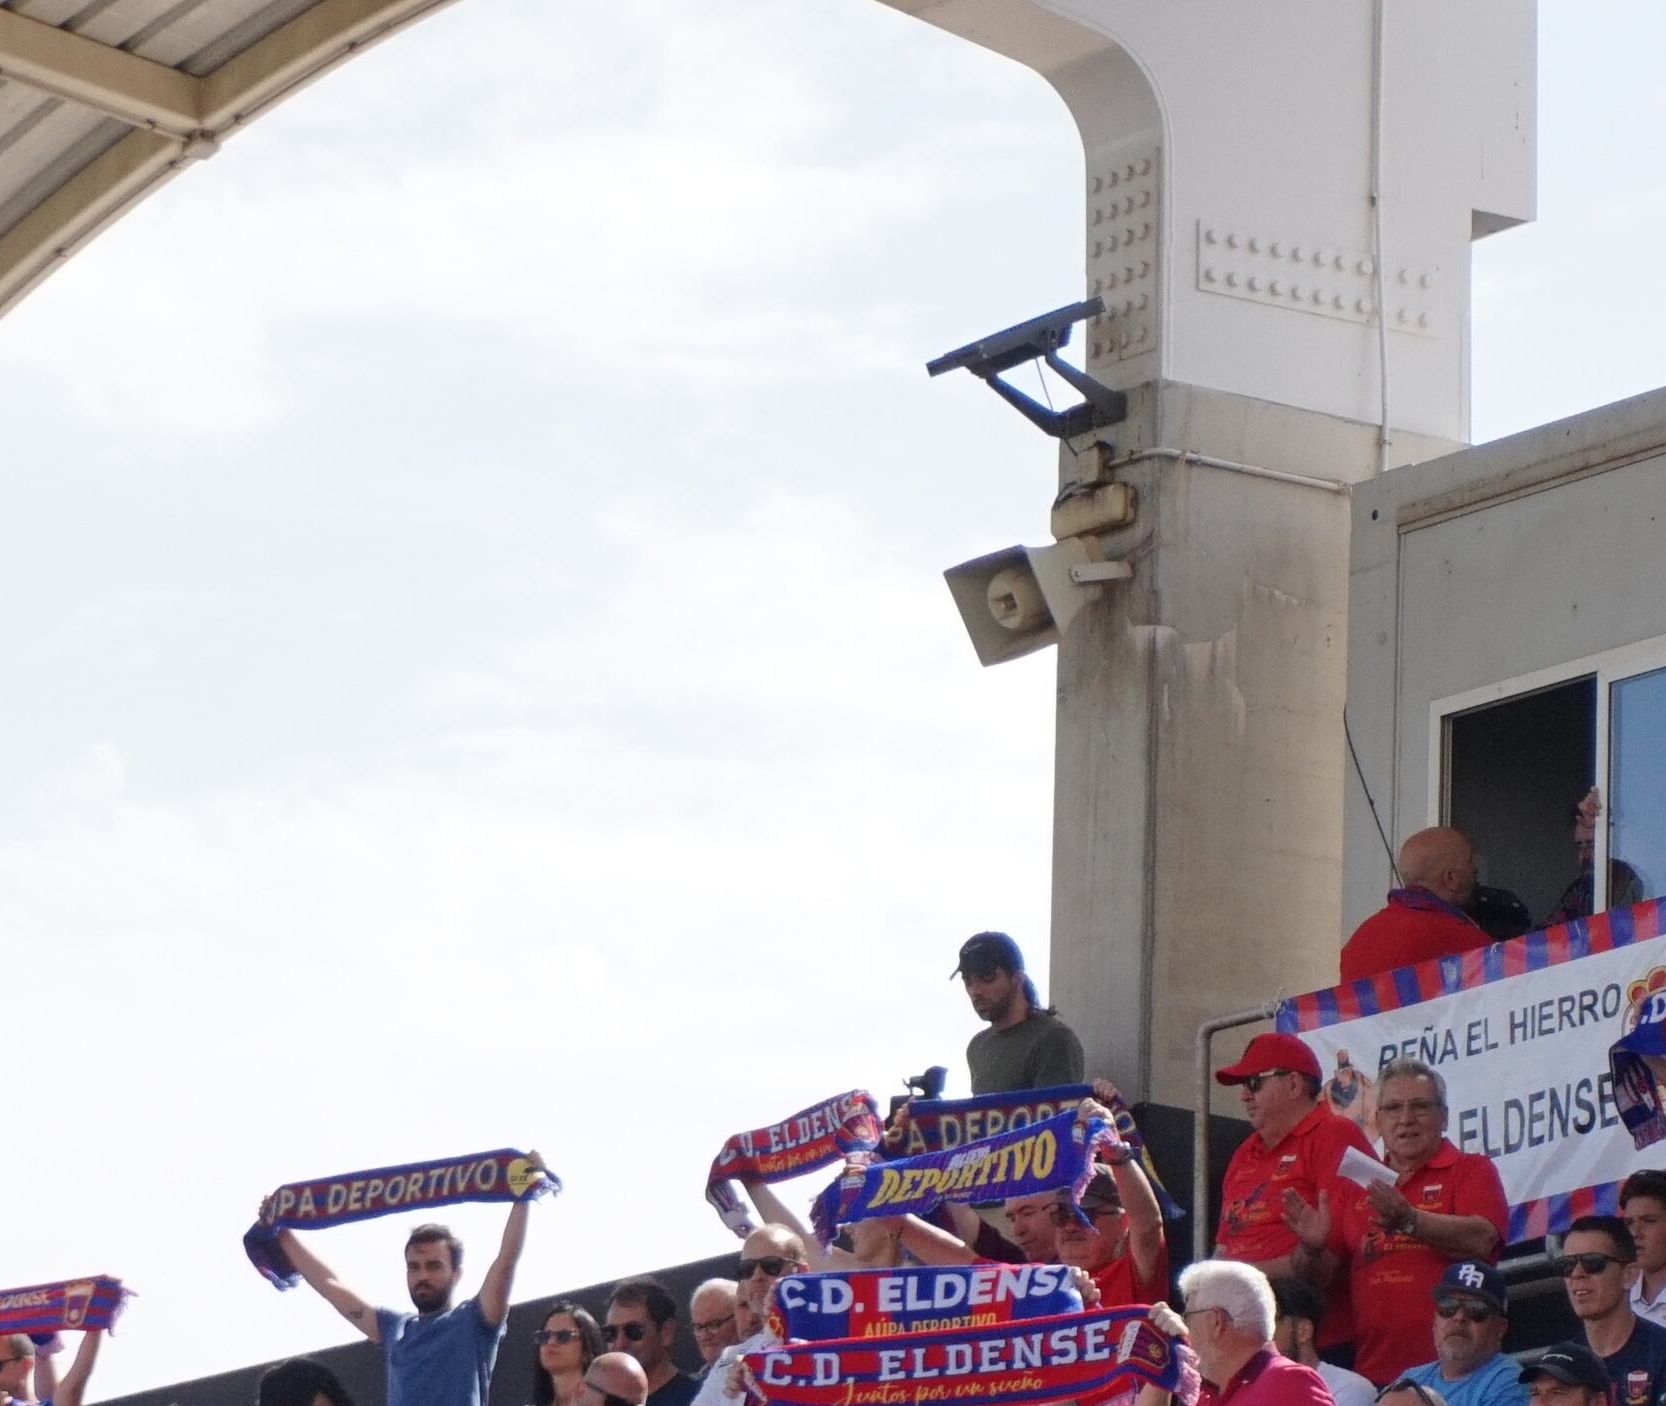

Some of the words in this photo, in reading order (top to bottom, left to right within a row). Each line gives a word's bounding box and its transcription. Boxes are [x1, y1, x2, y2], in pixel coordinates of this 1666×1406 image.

[1466, 1017, 1499, 1057] EL
[1509, 983, 1622, 1046] HIERRO
[1459, 1072, 1619, 1160] ELDENSE
[327, 1158, 498, 1214] DEPORTIVO
[867, 1129, 1057, 1209] DEPORTIVO
[779, 1277, 864, 1313] C.D.
[762, 1352, 854, 1386] C.D.
[878, 1320, 1111, 1382] ELDENSE
[915, 1382, 951, 1406] por
[956, 1381, 985, 1397] un
[989, 1370, 1043, 1395] sueño
